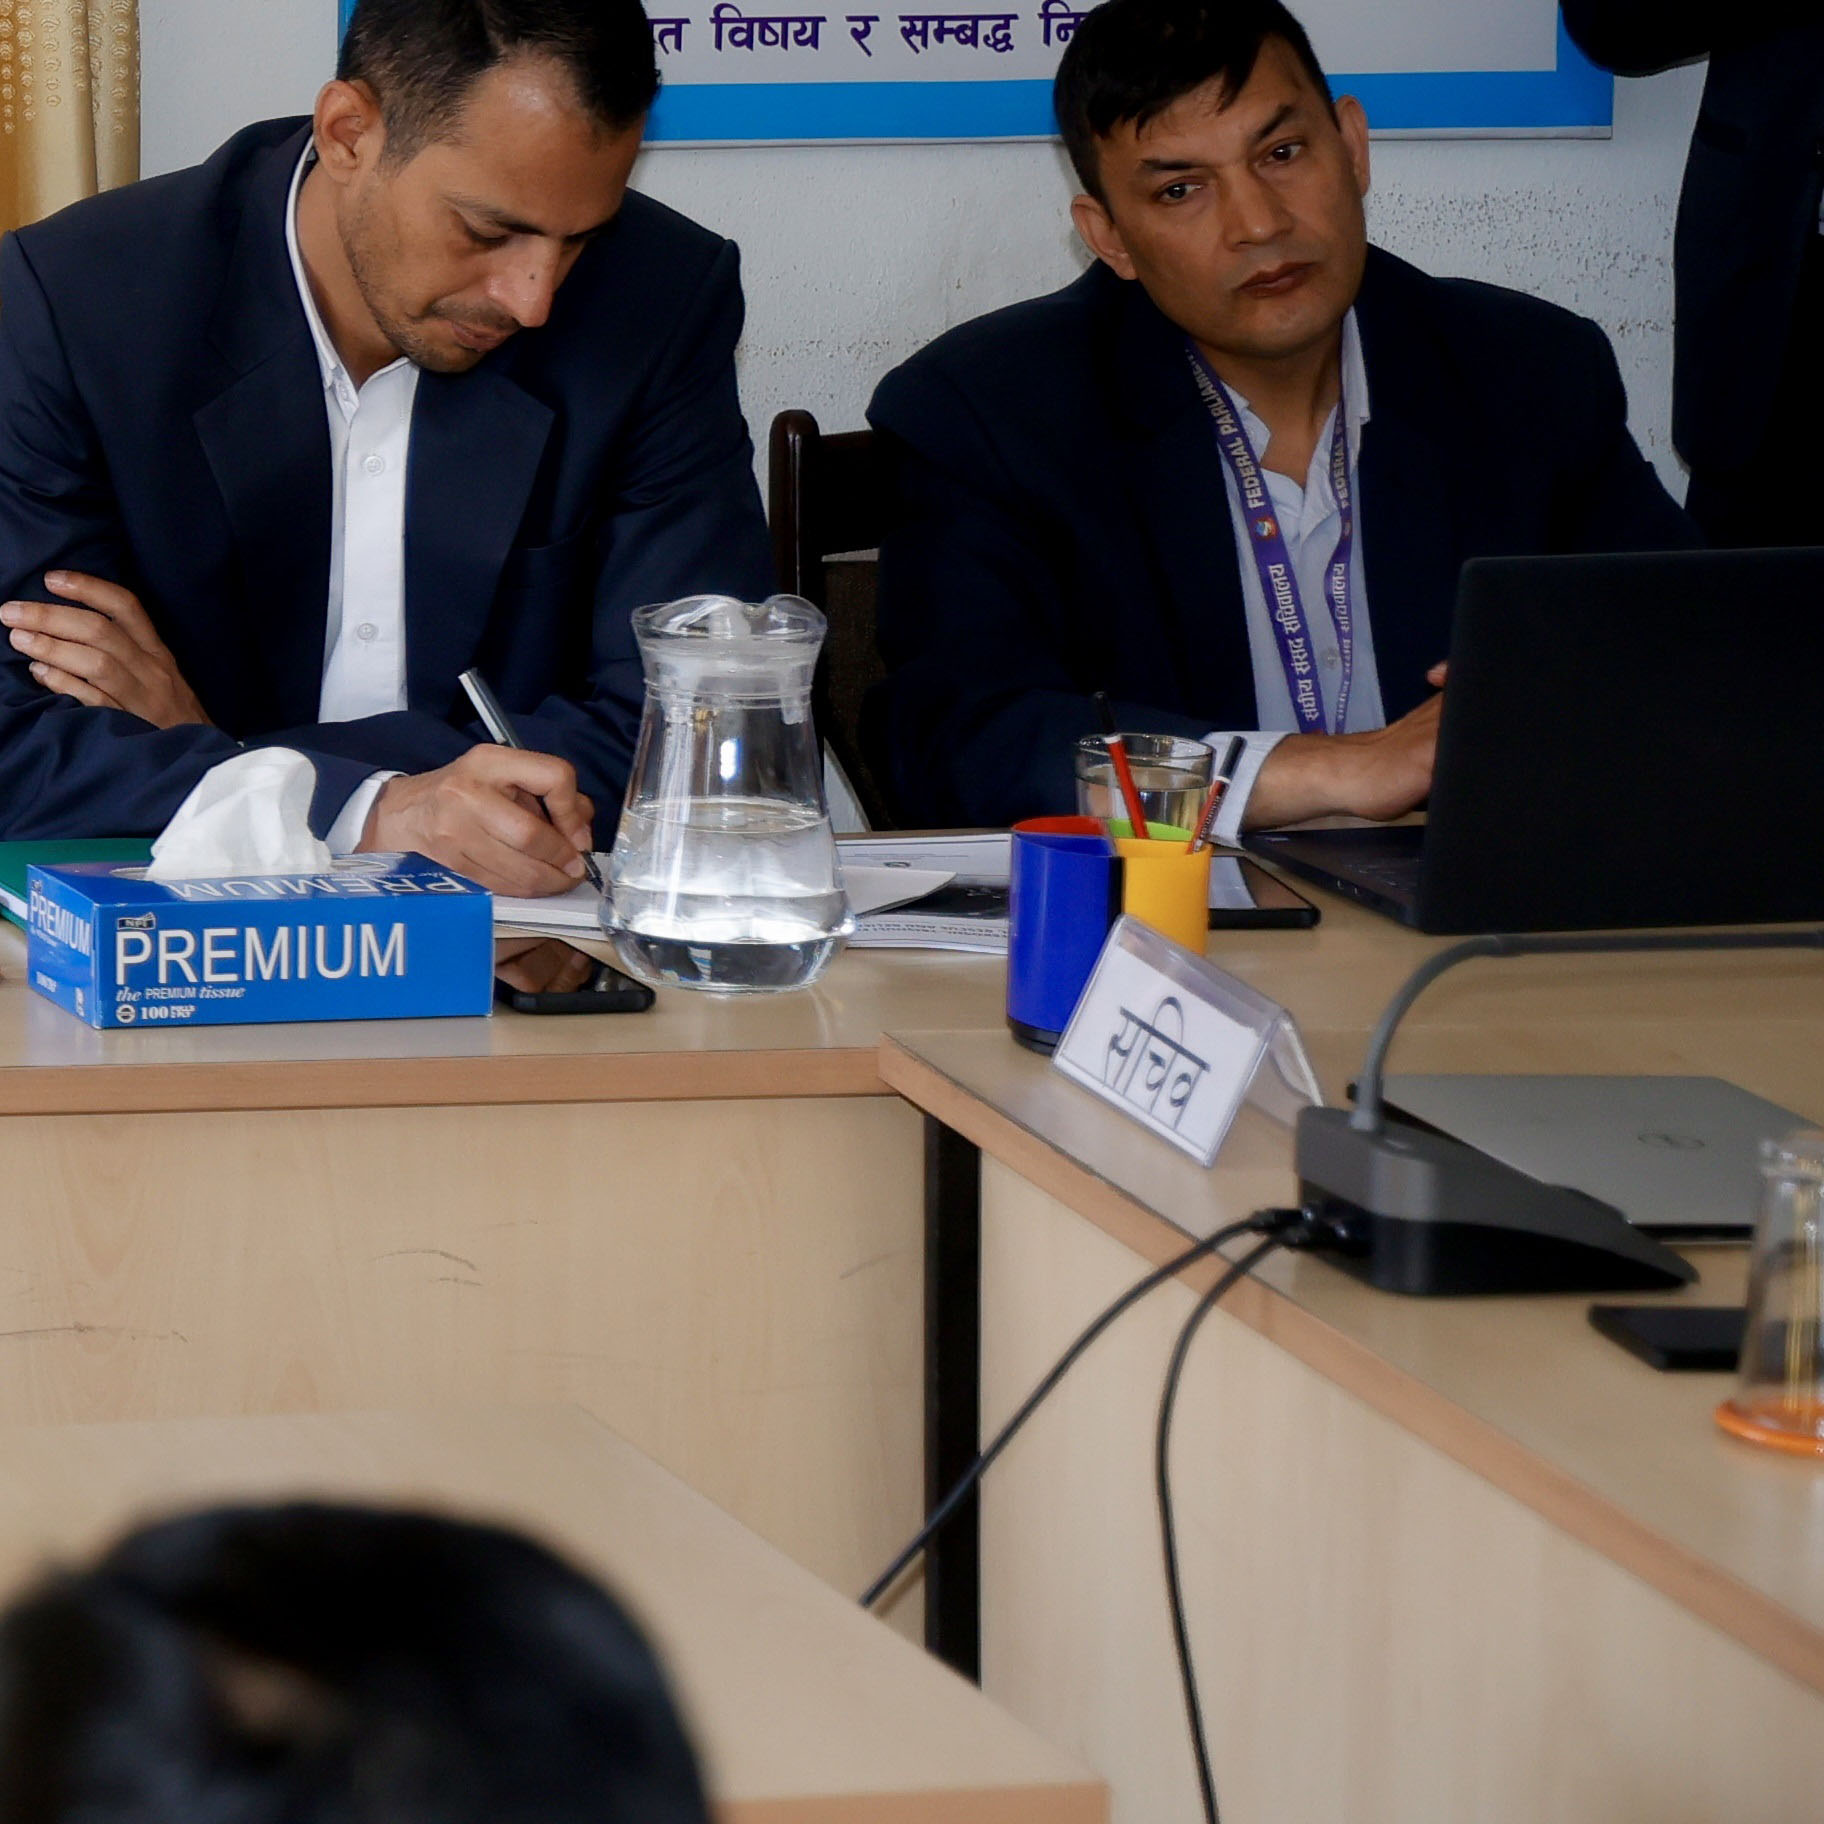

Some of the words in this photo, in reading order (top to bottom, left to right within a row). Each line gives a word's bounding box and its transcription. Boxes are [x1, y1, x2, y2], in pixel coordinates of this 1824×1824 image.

[709, 3, 827, 52] विषय
[845, 15, 880, 57] र
[898, 14, 1019, 54] सम्बद्ध
[1228, 437, 1265, 509] FEDERAL
[1268, 563, 1302, 635] सचिवालय
[165, 876, 471, 899] PREMIUM
[30, 890, 91, 956] PREMIUM
[116, 923, 406, 986] PREMIUM
[116, 986, 142, 1001] the
[145, 987, 197, 1000] PREMIUM
[199, 985, 246, 999] tissue
[141, 1006, 169, 1020] 100
[1103, 996, 1211, 1130] सचिव
